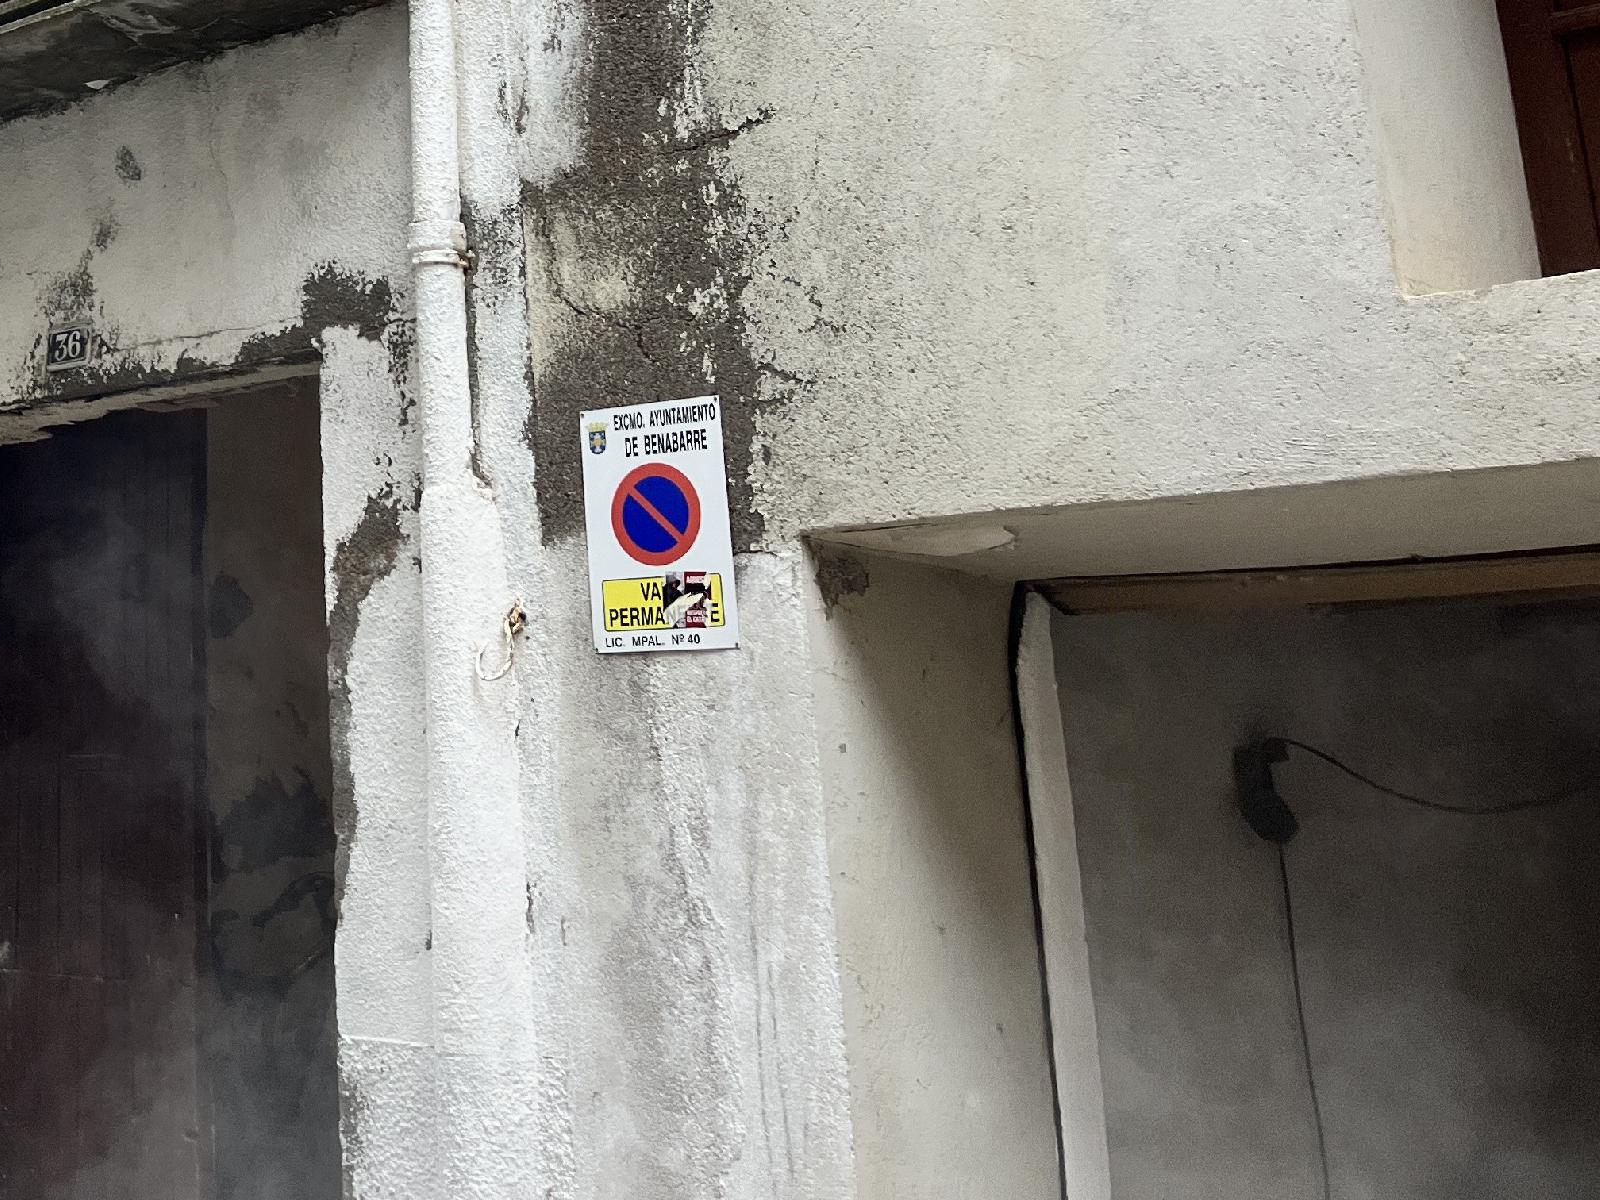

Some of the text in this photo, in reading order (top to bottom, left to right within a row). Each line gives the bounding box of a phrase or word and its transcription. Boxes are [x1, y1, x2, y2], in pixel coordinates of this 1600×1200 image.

[54, 330, 81, 360] 36
[613, 402, 716, 431] EXCMO. AYUNTAMIENTO
[624, 428, 708, 458] DE BENABARRE
[605, 636, 626, 648] LIC.
[631, 634, 666, 647] MPAL.
[687, 633, 701, 644] 40
